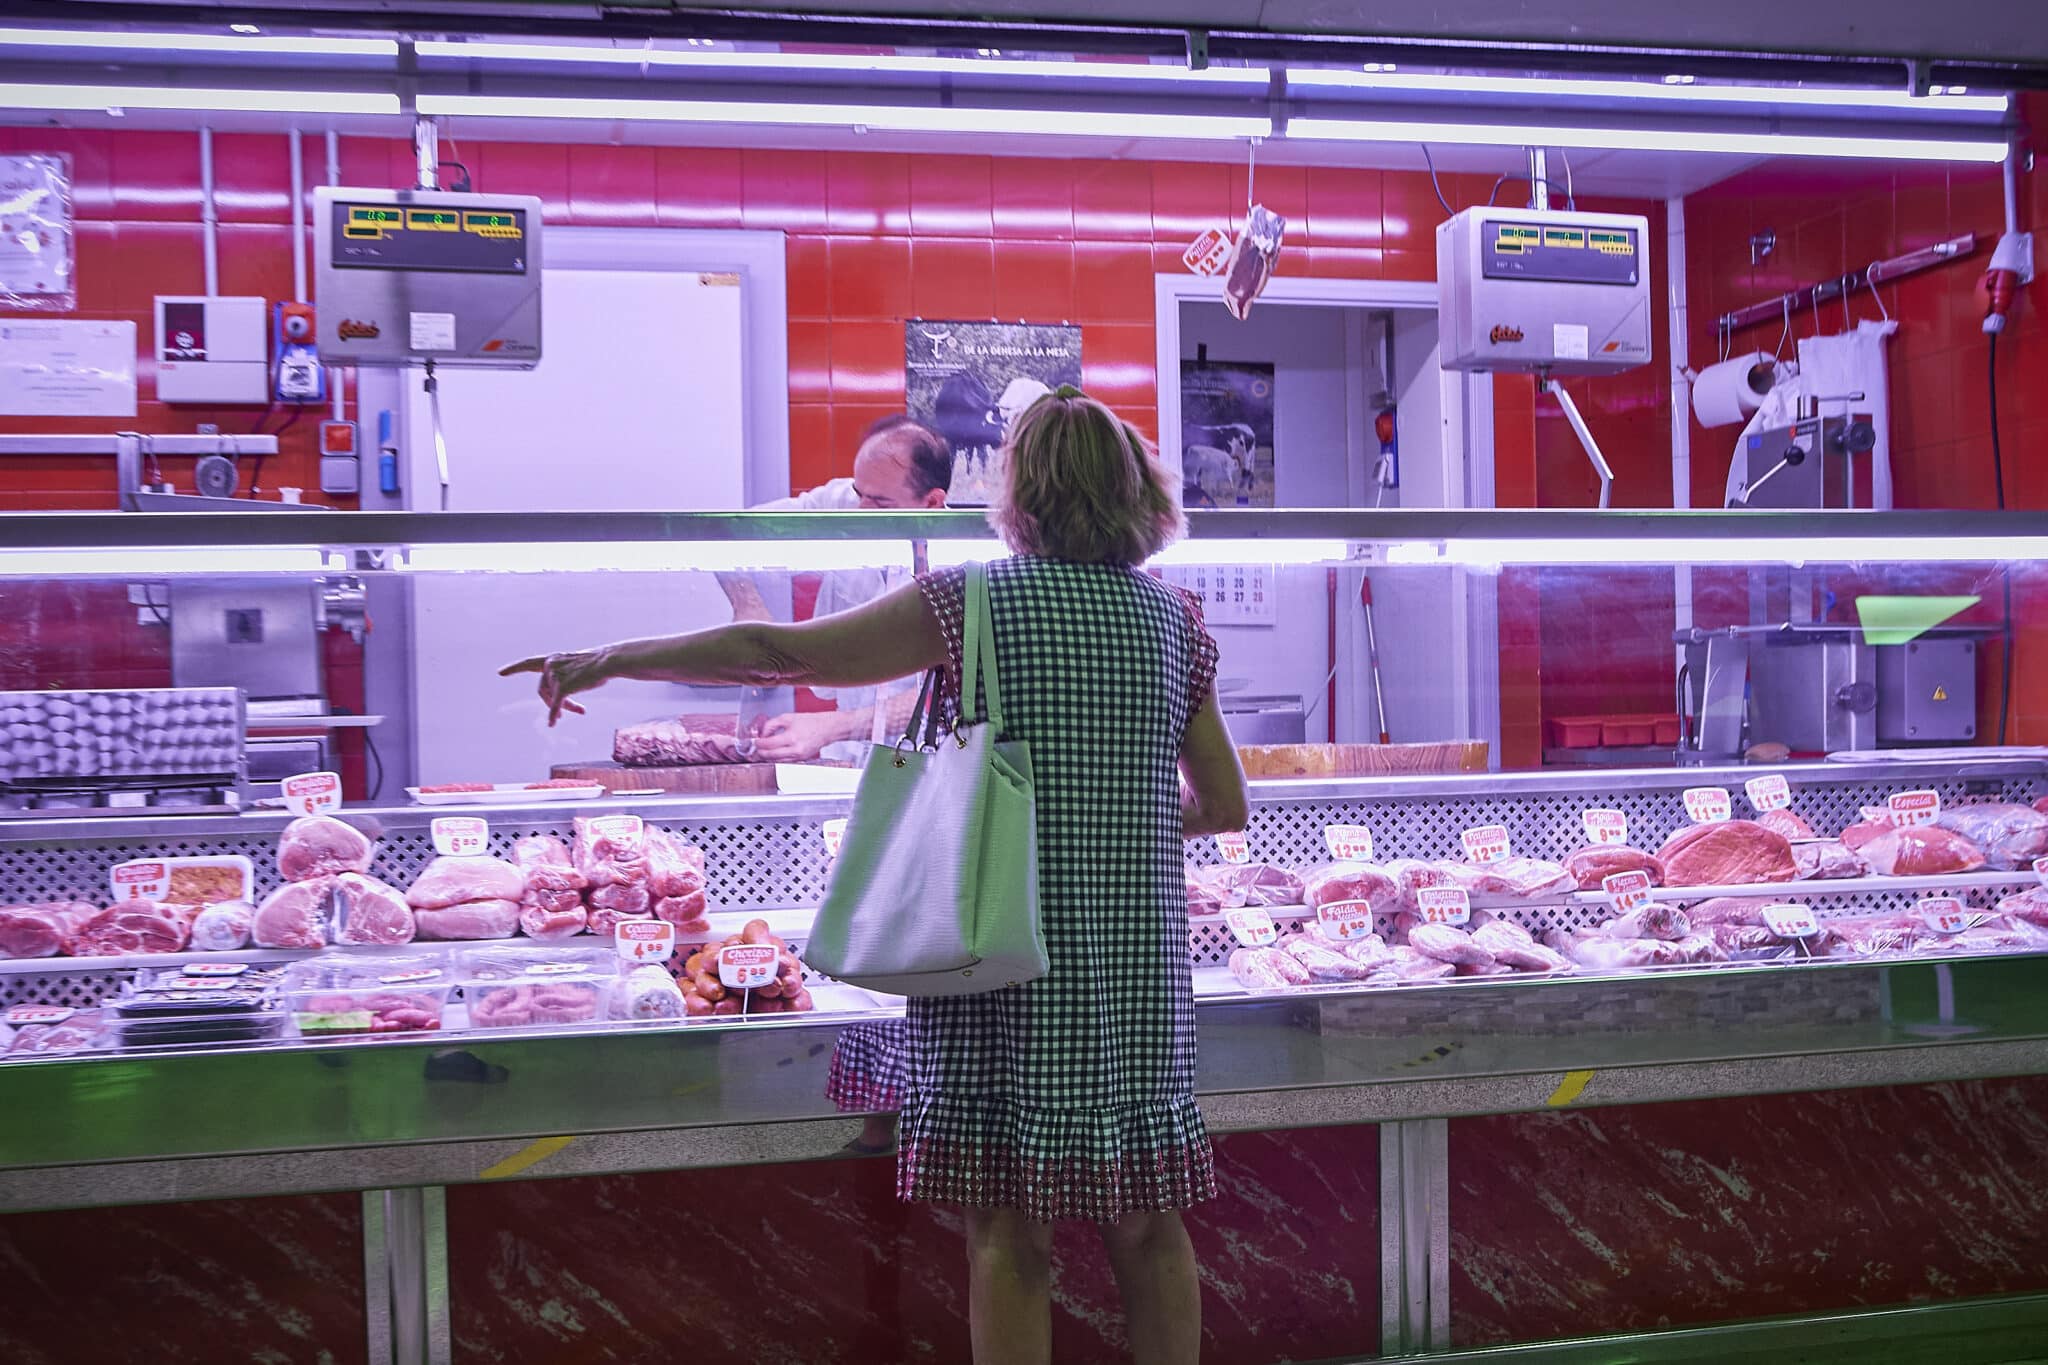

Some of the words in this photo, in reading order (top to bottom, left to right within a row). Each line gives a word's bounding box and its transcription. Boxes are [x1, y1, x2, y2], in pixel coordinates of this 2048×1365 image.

[964, 344, 976, 356] DE
[977, 345, 989, 356] LA
[1024, 346, 1033, 357] A
[1033, 346, 1045, 357] LA
[1216, 577, 1225, 588] 19
[1234, 578, 1244, 588] 20
[1254, 578, 1262, 588] 21
[1216, 592, 1225, 602] 26
[1234, 592, 1244, 602] 27
[1254, 592, 1263, 602] 28
